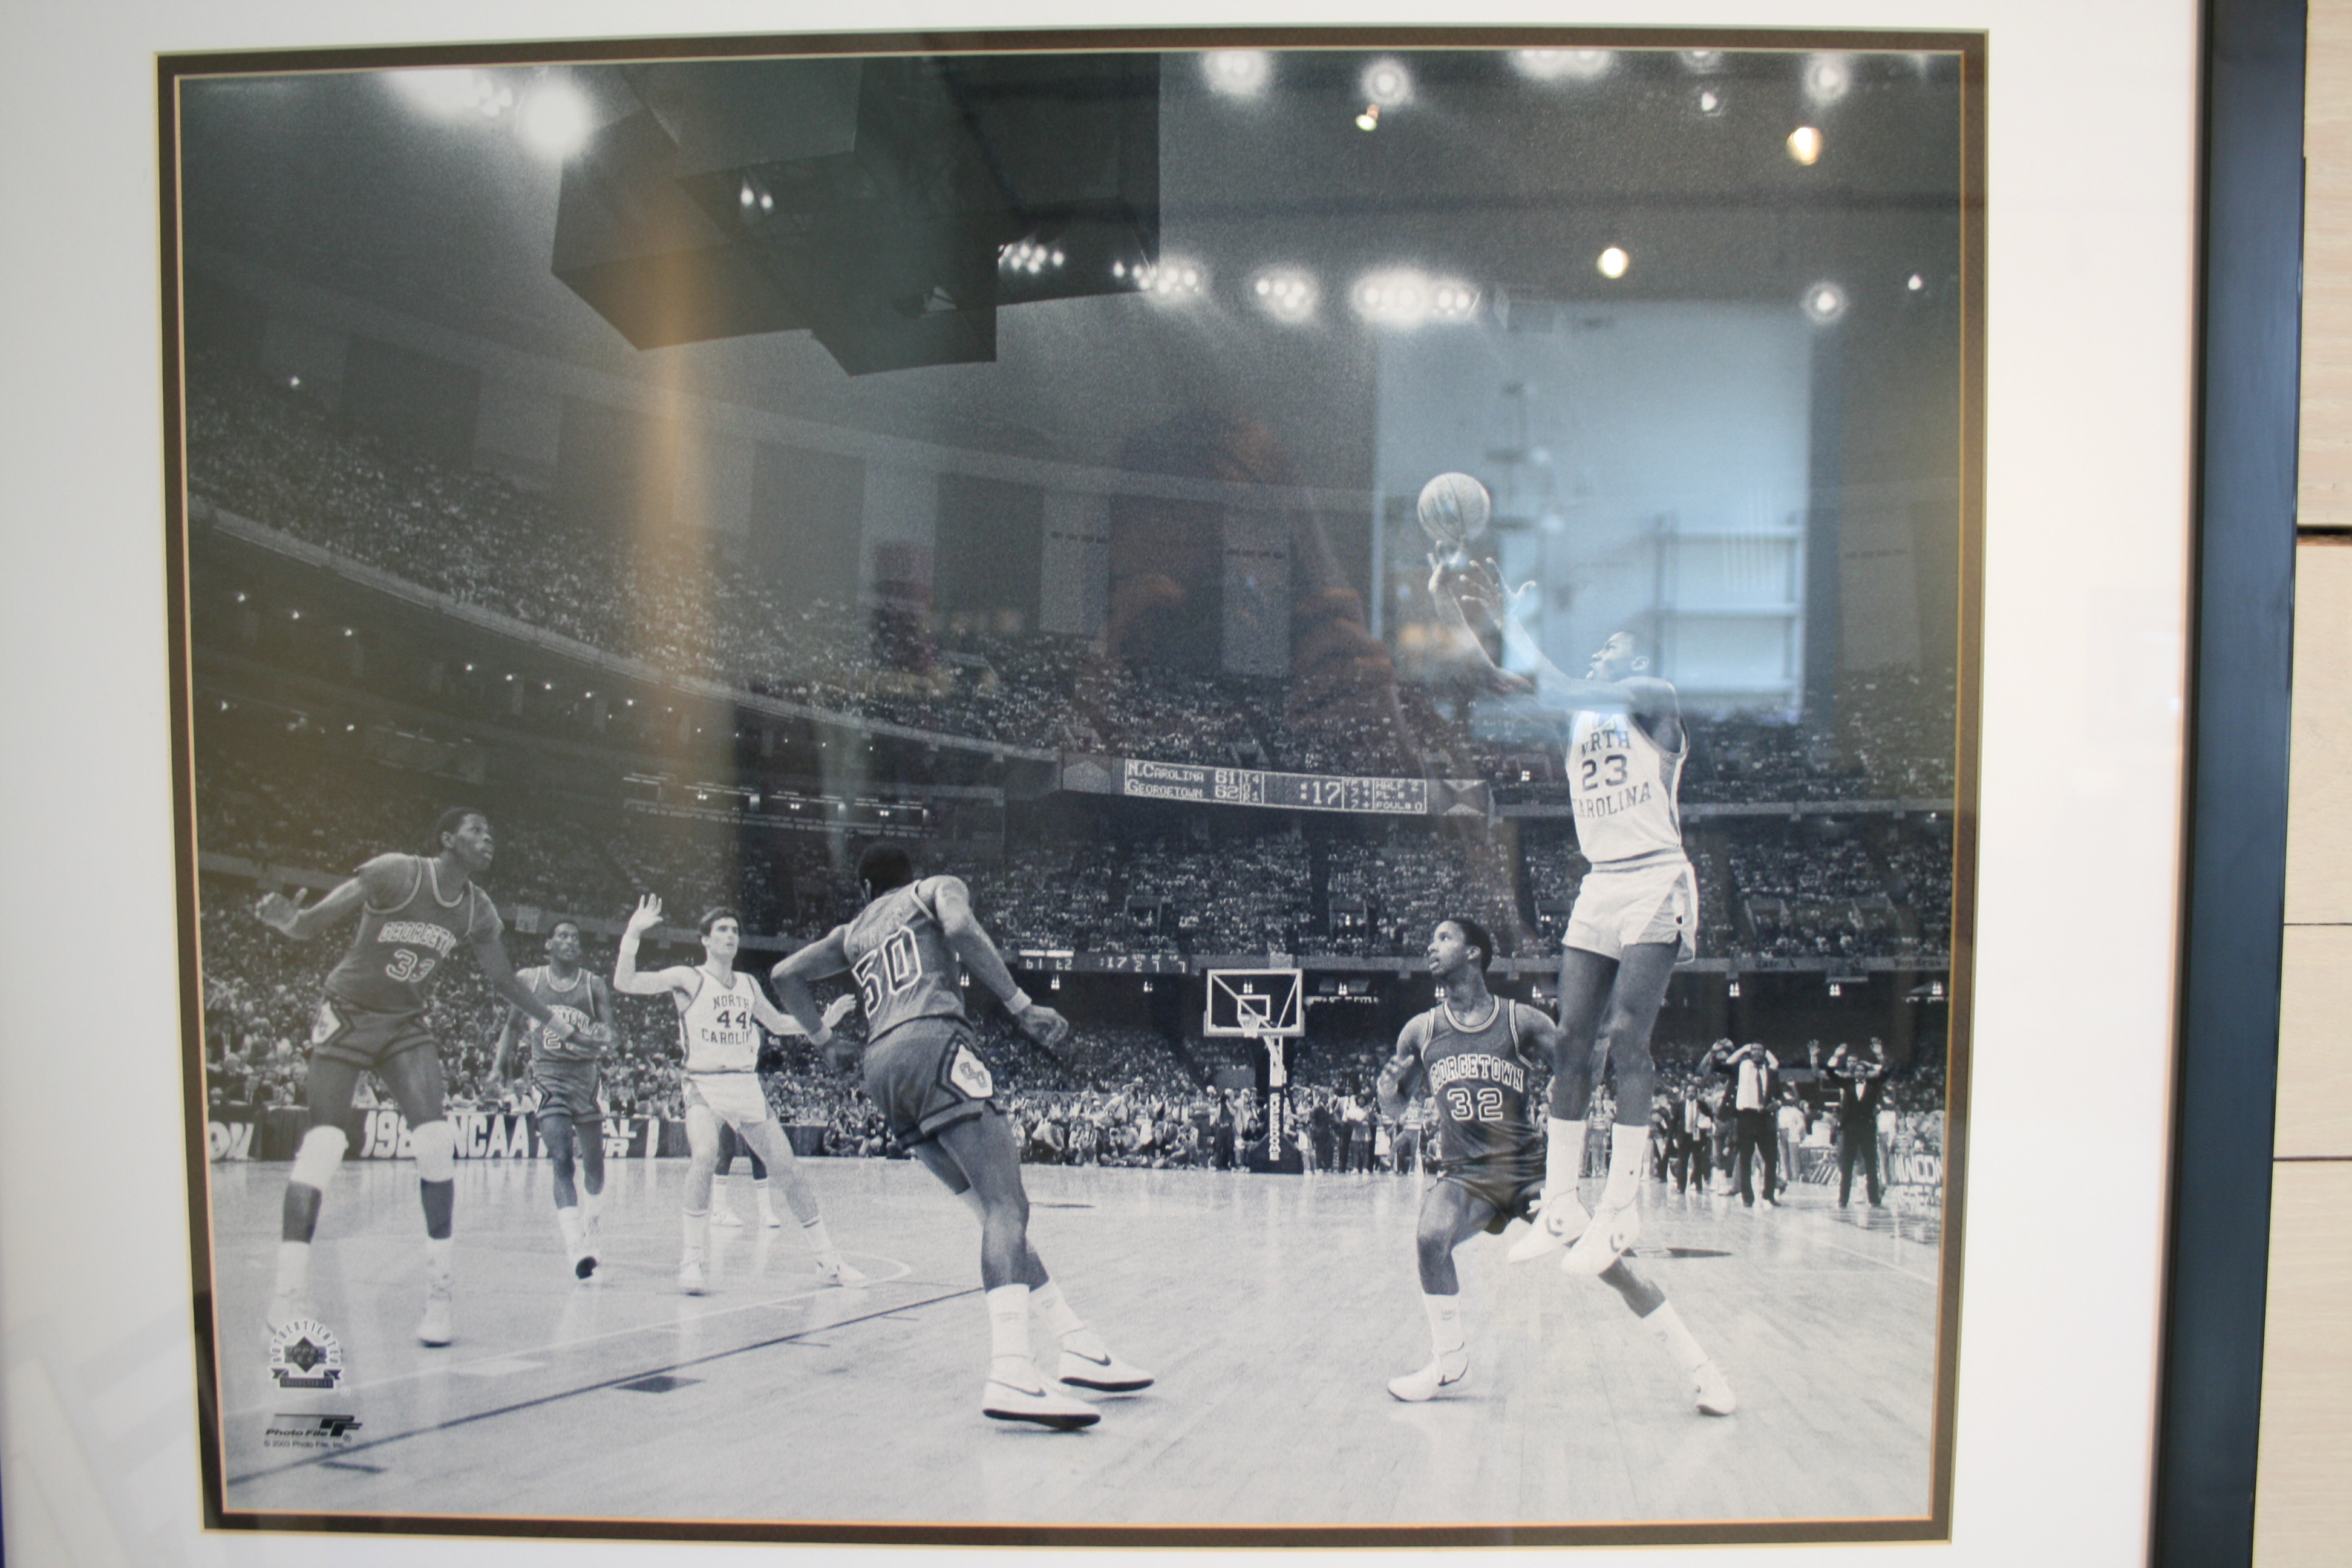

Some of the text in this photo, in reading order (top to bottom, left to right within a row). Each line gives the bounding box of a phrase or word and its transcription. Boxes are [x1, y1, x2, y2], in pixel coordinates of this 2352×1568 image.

[1215, 769, 1236, 785] 61
[1582, 754, 1627, 792] 23
[1126, 779, 1239, 800] GEORGETOWN 62
[1411, 780, 1418, 792] 2
[851, 925, 922, 1019] 50
[713, 994, 750, 1010] NORTH
[717, 1010, 747, 1028] 44
[1447, 1087, 1503, 1122] 32
[447, 1114, 529, 1158] NCAA
[266, 1428, 304, 1437] Photo
